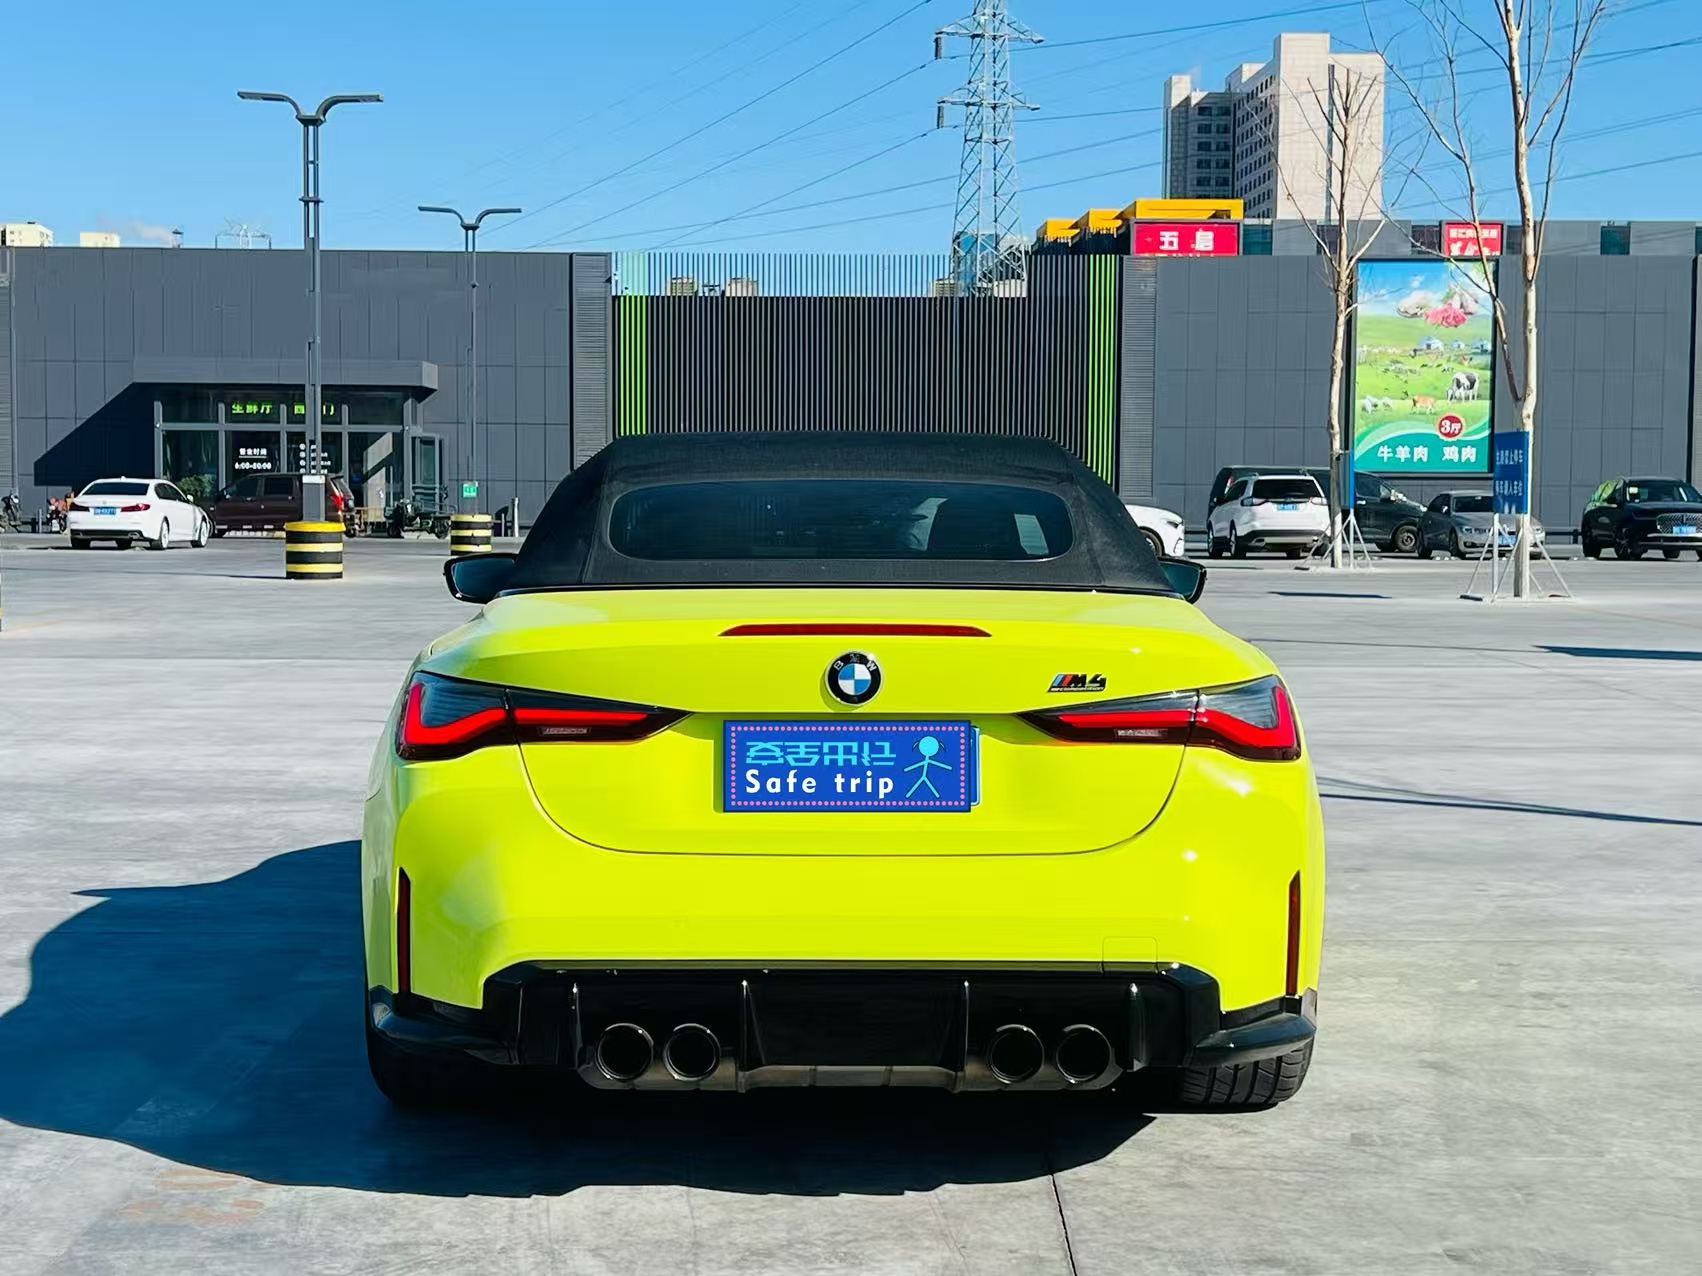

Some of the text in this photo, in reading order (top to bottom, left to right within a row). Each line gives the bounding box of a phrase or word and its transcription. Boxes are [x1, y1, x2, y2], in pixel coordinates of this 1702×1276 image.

[1441, 419, 1461, 435] 3厅
[1377, 445, 1477, 463] 牛羊肉 鸡肉
[833, 653, 877, 671] BMW
